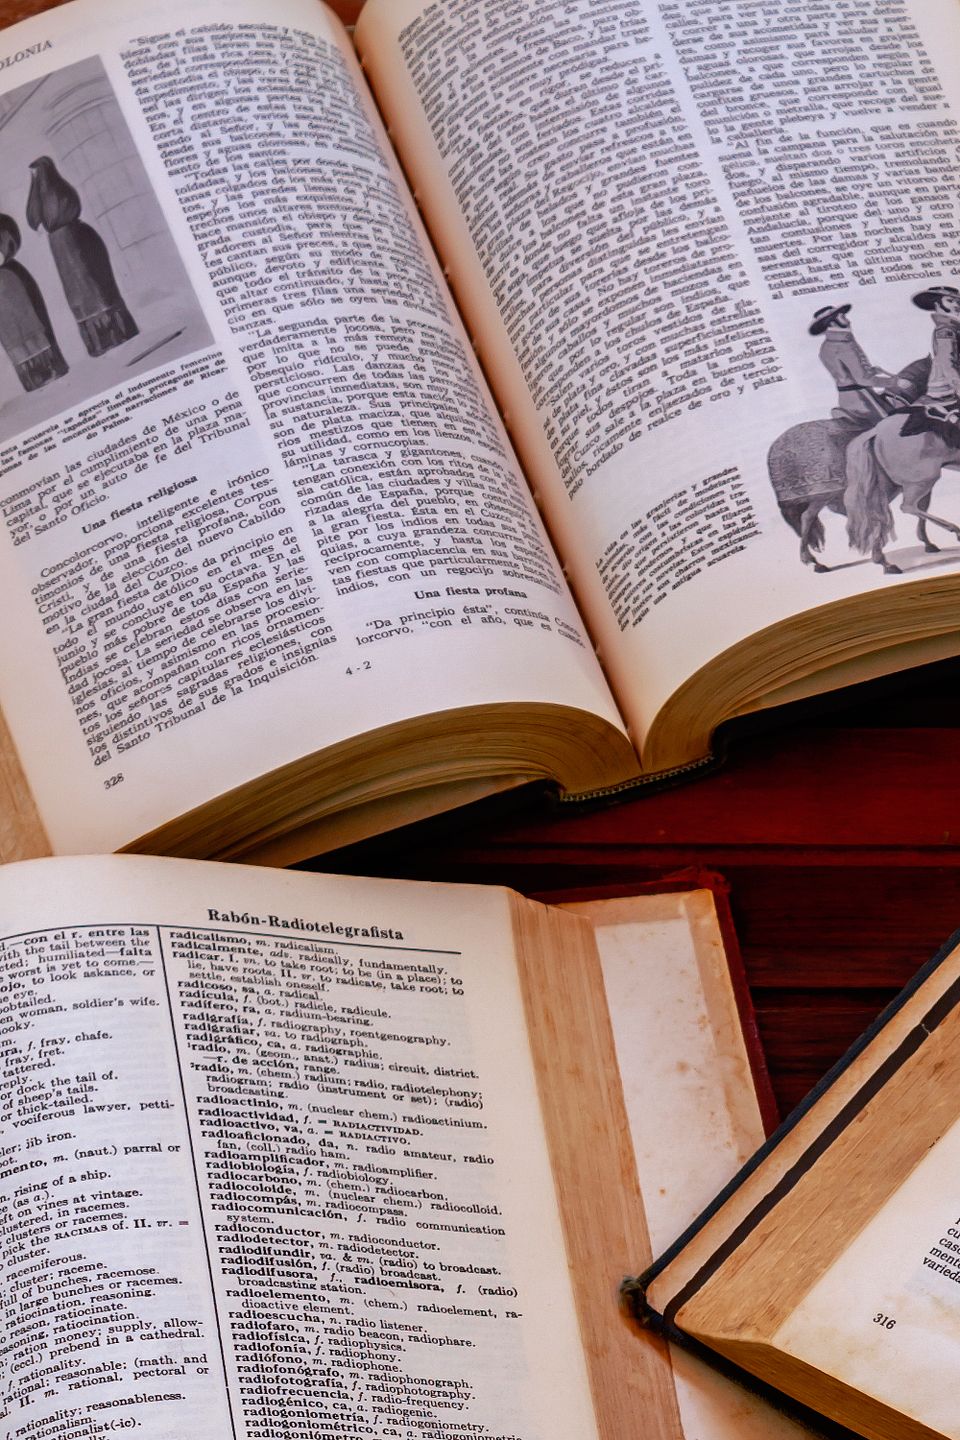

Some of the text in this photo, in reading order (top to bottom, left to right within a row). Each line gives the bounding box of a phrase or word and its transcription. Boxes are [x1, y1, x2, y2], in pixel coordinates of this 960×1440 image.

[81, 475, 199, 534] Una fiesta religiosa
[40, 467, 270, 578] Concolorcorvo, inteligente e irónico
[413, 586, 528, 600] Una fiesta profana
[92, 749, 112, 767] del
[116, 731, 151, 755] Santo
[155, 701, 206, 733] Tribunal
[211, 694, 227, 705] de
[228, 680, 244, 696] la
[103, 772, 125, 790] 328
[207, 908, 404, 941] Rabón-Radiotelegrafista
[200, 1129, 311, 1150] radioaficionado,
[318, 1137, 339, 1151] da,
[365, 1144, 396, 1156] radio
[402, 1149, 457, 1163] amateur,
[463, 1153, 495, 1165] radio
[228, 1306, 325, 1325] radioescucha,
[344, 1317, 377, 1329] radio
[379, 1319, 428, 1333] listener.
[872, 1312, 897, 1330] 316
